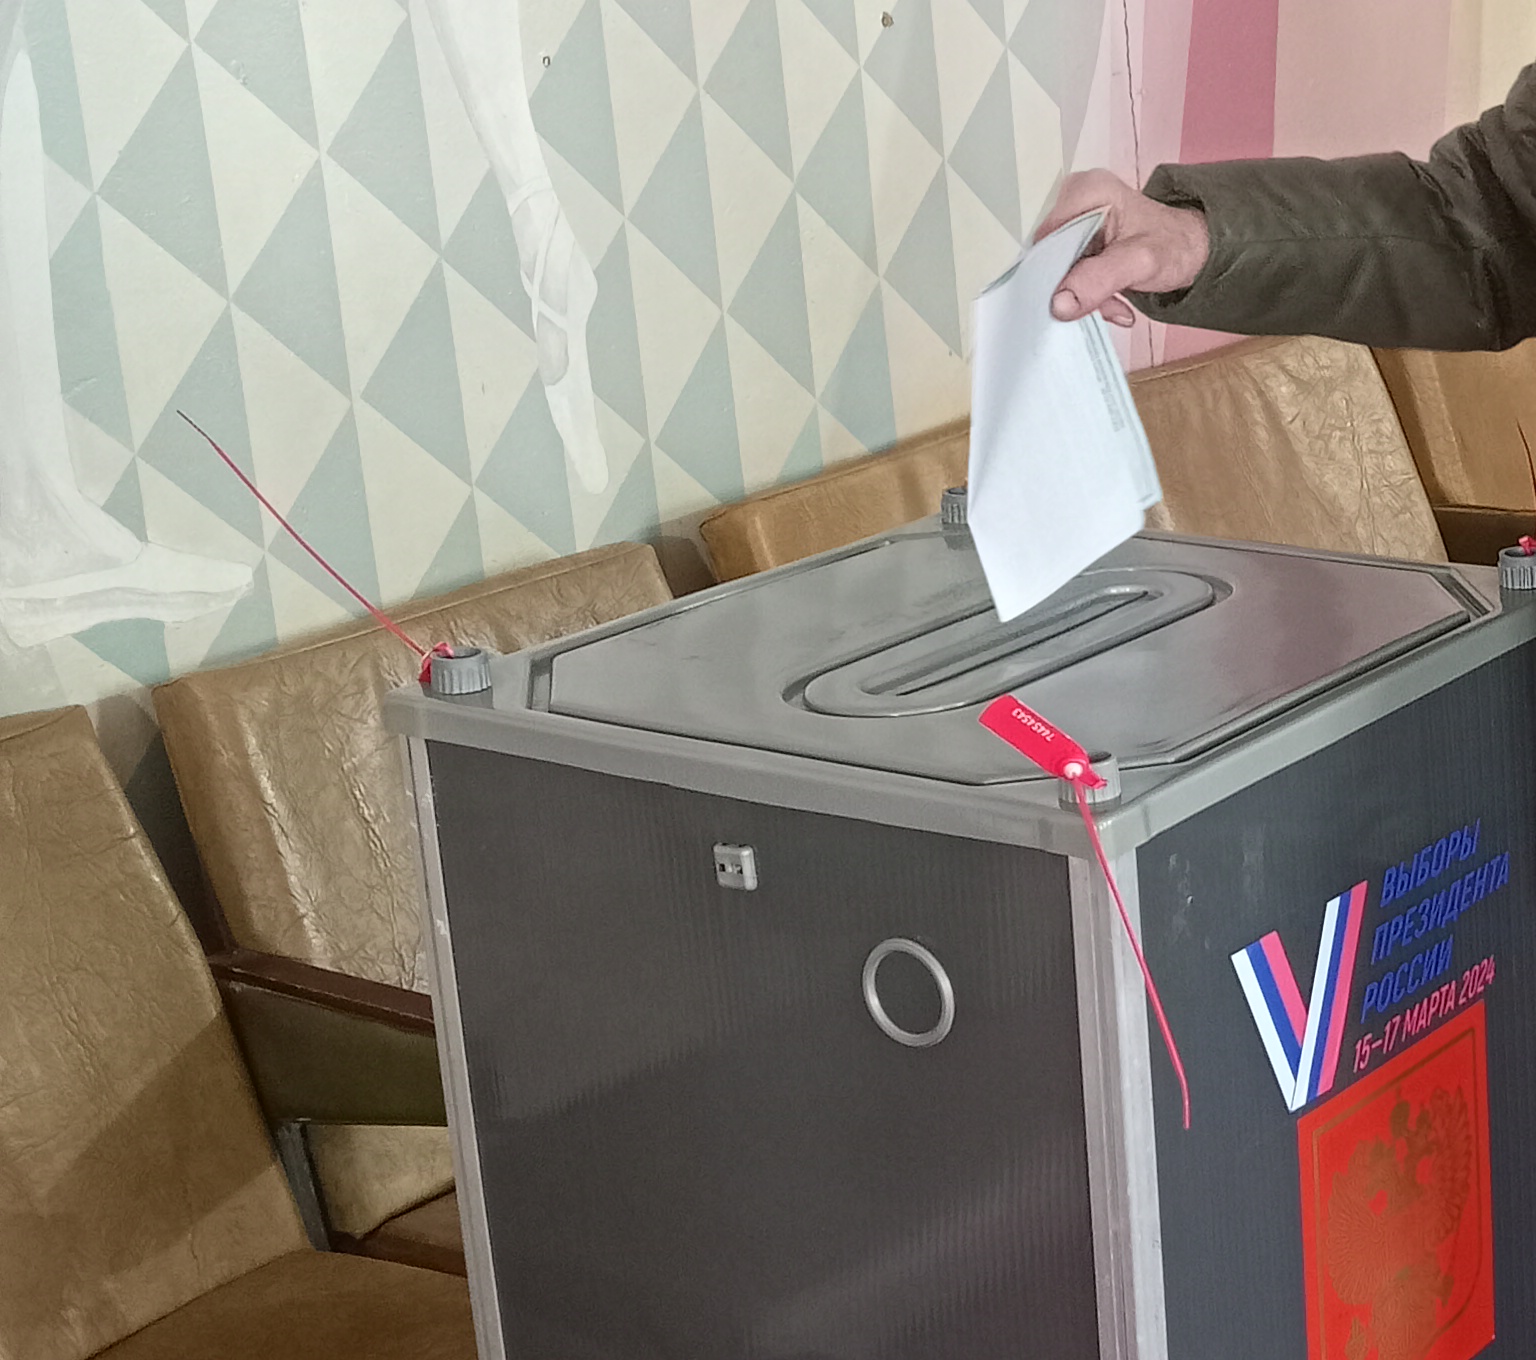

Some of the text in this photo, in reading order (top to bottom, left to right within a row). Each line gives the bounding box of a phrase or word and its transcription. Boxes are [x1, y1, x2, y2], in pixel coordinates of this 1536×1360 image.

[1379, 817, 1481, 908] ВЫБОРЫ
[1370, 851, 1511, 966] ПРЕЗИДЕНТА
[1360, 934, 1454, 1025] РОССИИ
[1401, 979, 1457, 1043] МАРТА
[1457, 953, 1496, 1006] 2024
